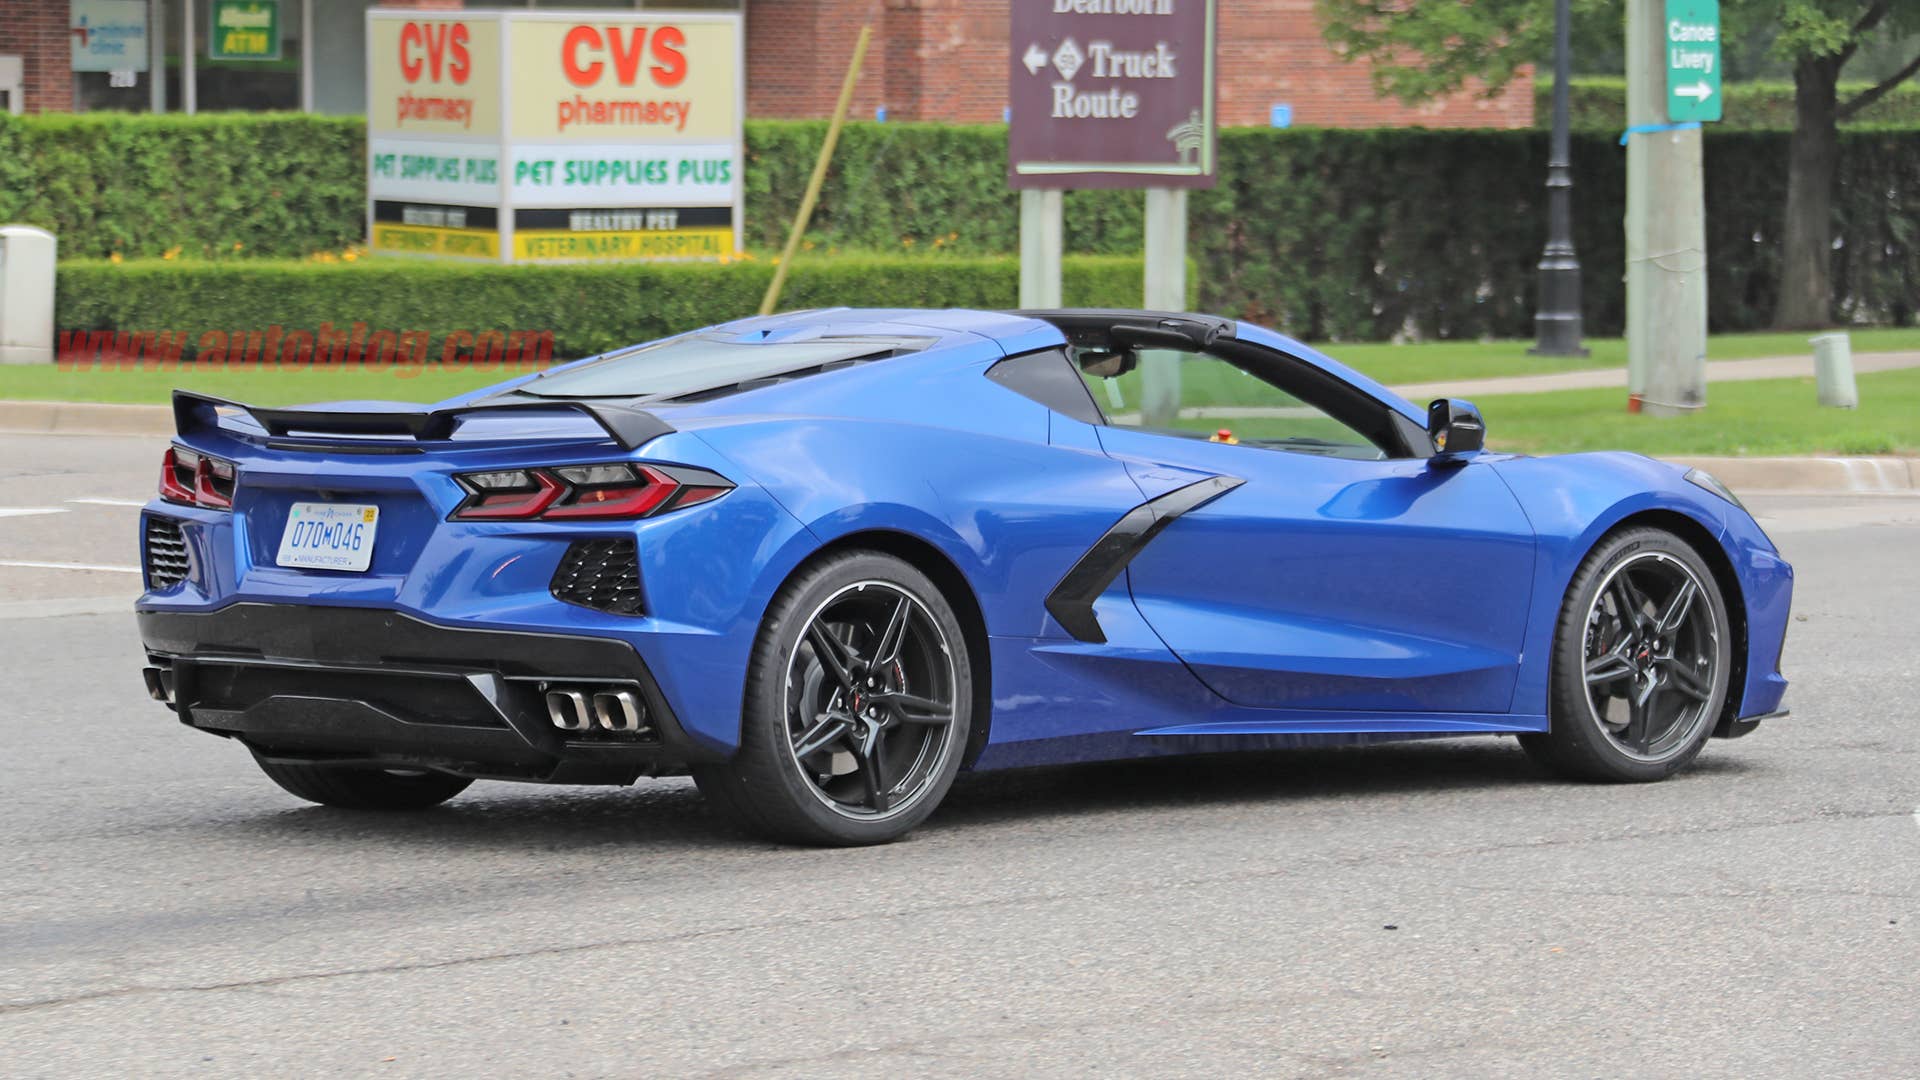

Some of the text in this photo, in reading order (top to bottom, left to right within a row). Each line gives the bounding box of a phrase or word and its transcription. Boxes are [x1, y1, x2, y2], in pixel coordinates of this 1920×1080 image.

[223, 32, 270, 54] ATM
[1669, 19, 1716, 42] Canoe
[400, 22, 471, 85] CVS
[561, 25, 688, 87] CVS
[1088, 41, 1176, 78] Truck
[1671, 48, 1714, 74] Livery
[397, 91, 474, 130] pharmacy
[558, 94, 691, 133] pharmacy
[1051, 83, 1138, 118] Route
[374, 153, 497, 185] PET SUPPLIES PLUS
[515, 159, 732, 186] PET SUPPLIES PLUS
[569, 210, 678, 231] HEALTHY PET
[525, 234, 722, 257] VETERINARY HOSPITAL
[291, 521, 364, 551] 070M046
